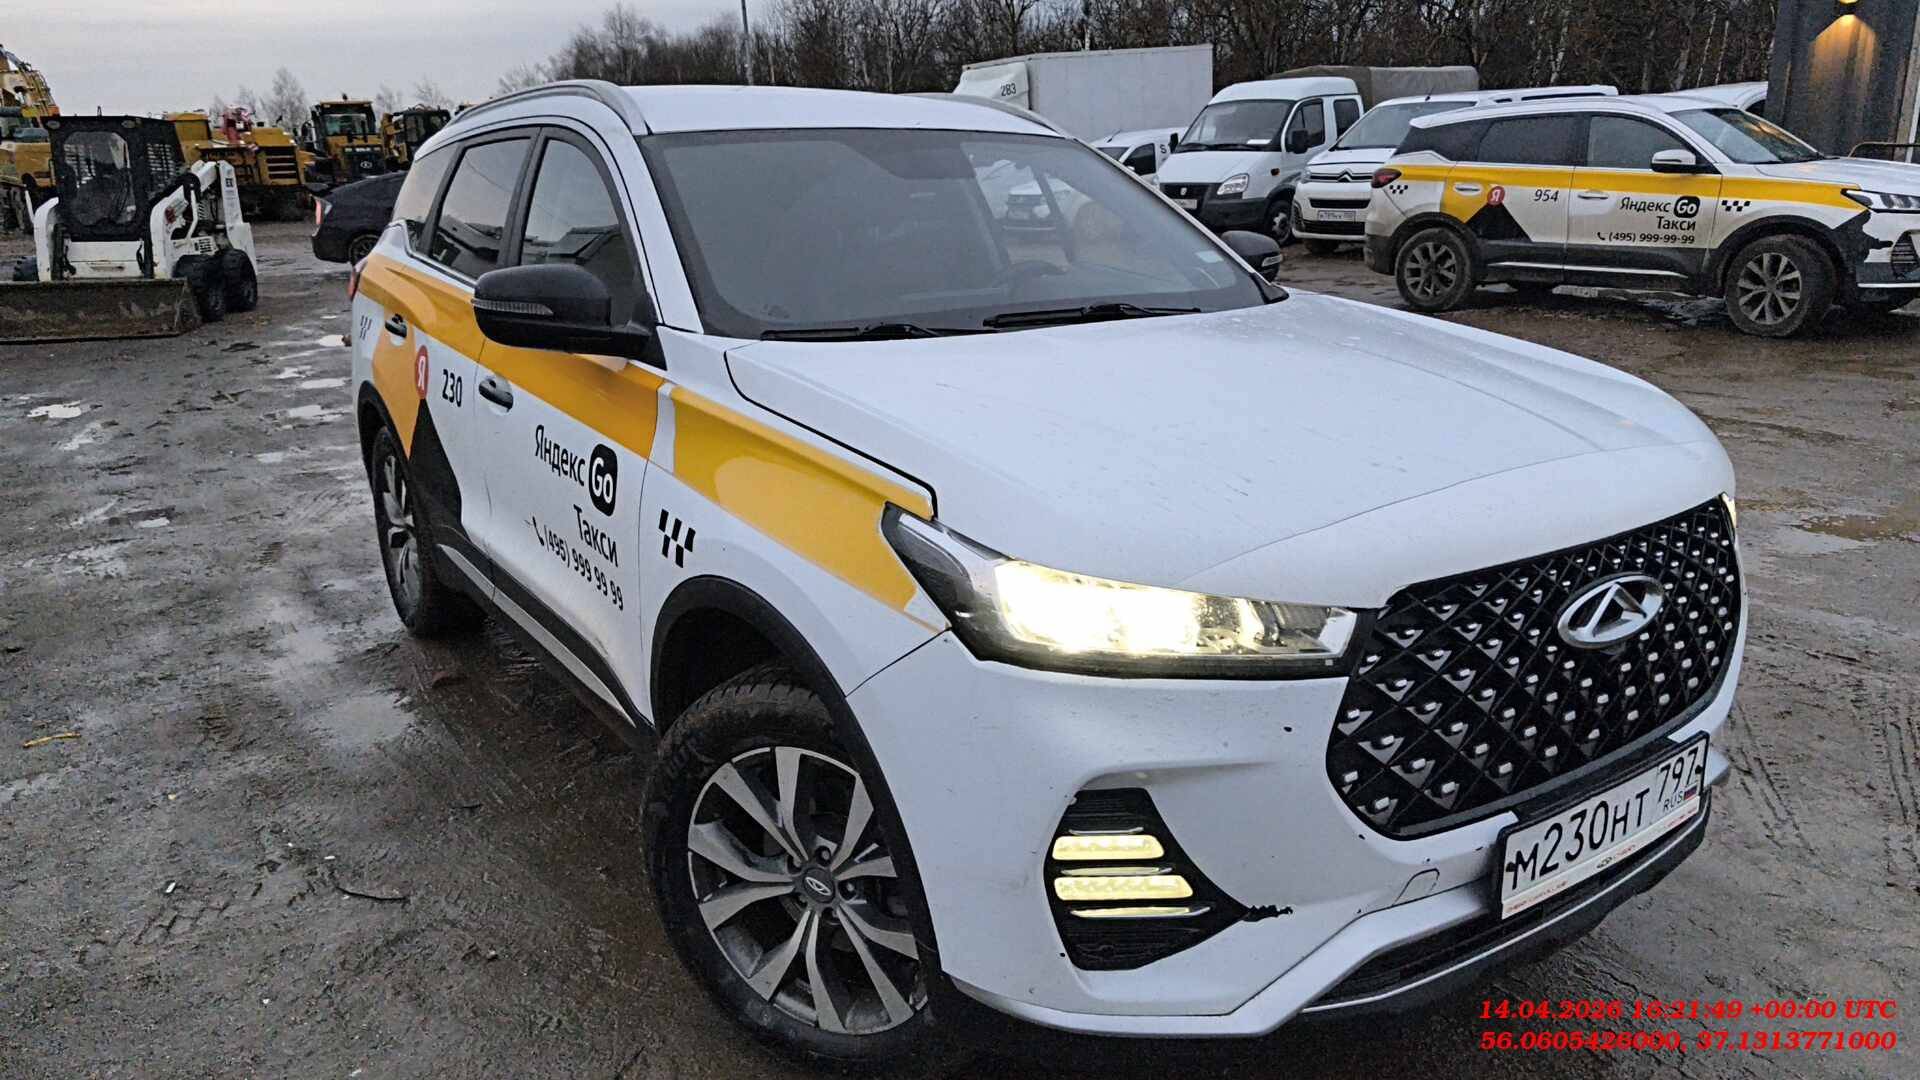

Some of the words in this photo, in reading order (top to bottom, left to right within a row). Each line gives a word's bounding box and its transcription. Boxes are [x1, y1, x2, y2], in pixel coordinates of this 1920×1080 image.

[1000, 82, 1017, 97] 283
[1490, 189, 1502, 202] Я
[1533, 188, 1559, 203] 954
[1619, 197, 1671, 213] Яндекс
[1677, 200, 1697, 215] Go
[1655, 215, 1696, 230] Такси
[1608, 231, 1637, 244] (495)
[1639, 231, 1695, 244] 999-99-99
[442, 368, 464, 408] 230
[534, 424, 586, 487] Яндекс
[591, 456, 614, 505] Go
[573, 504, 619, 567] Такси
[544, 525, 571, 569] (495)
[571, 547, 592, 583] 999
[593, 566, 608, 597] 99
[609, 580, 625, 612] 99
[1663, 794, 1685, 812] RUS
[1511, 786, 1651, 891] М230НТ
[1657, 747, 1699, 804] 797
